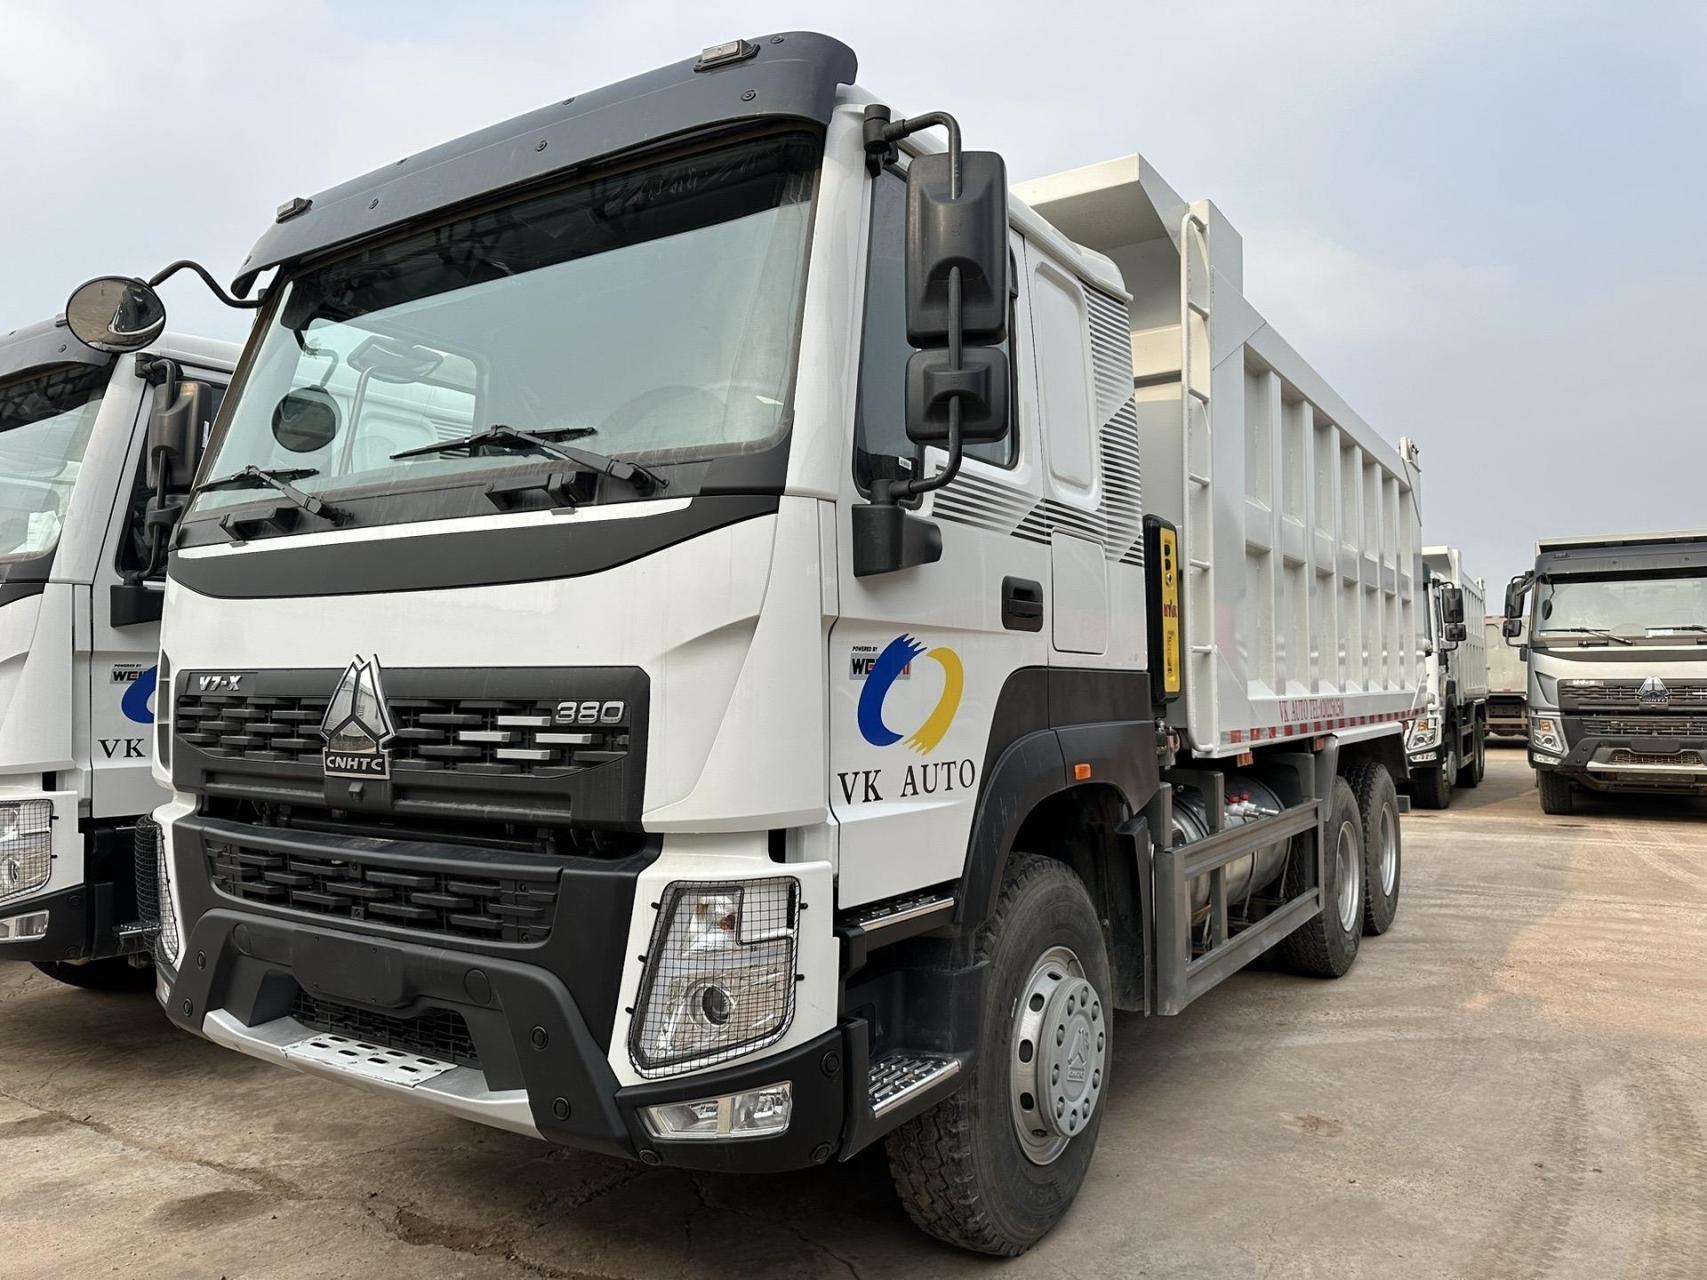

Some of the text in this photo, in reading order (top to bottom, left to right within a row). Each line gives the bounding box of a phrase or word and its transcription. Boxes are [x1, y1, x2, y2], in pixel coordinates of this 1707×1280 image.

[200, 675, 241, 691] V7-X
[555, 701, 624, 723] 380
[97, 738, 146, 759] VK
[327, 756, 383, 771] CNHTC
[837, 759, 975, 805] VK AUTO
